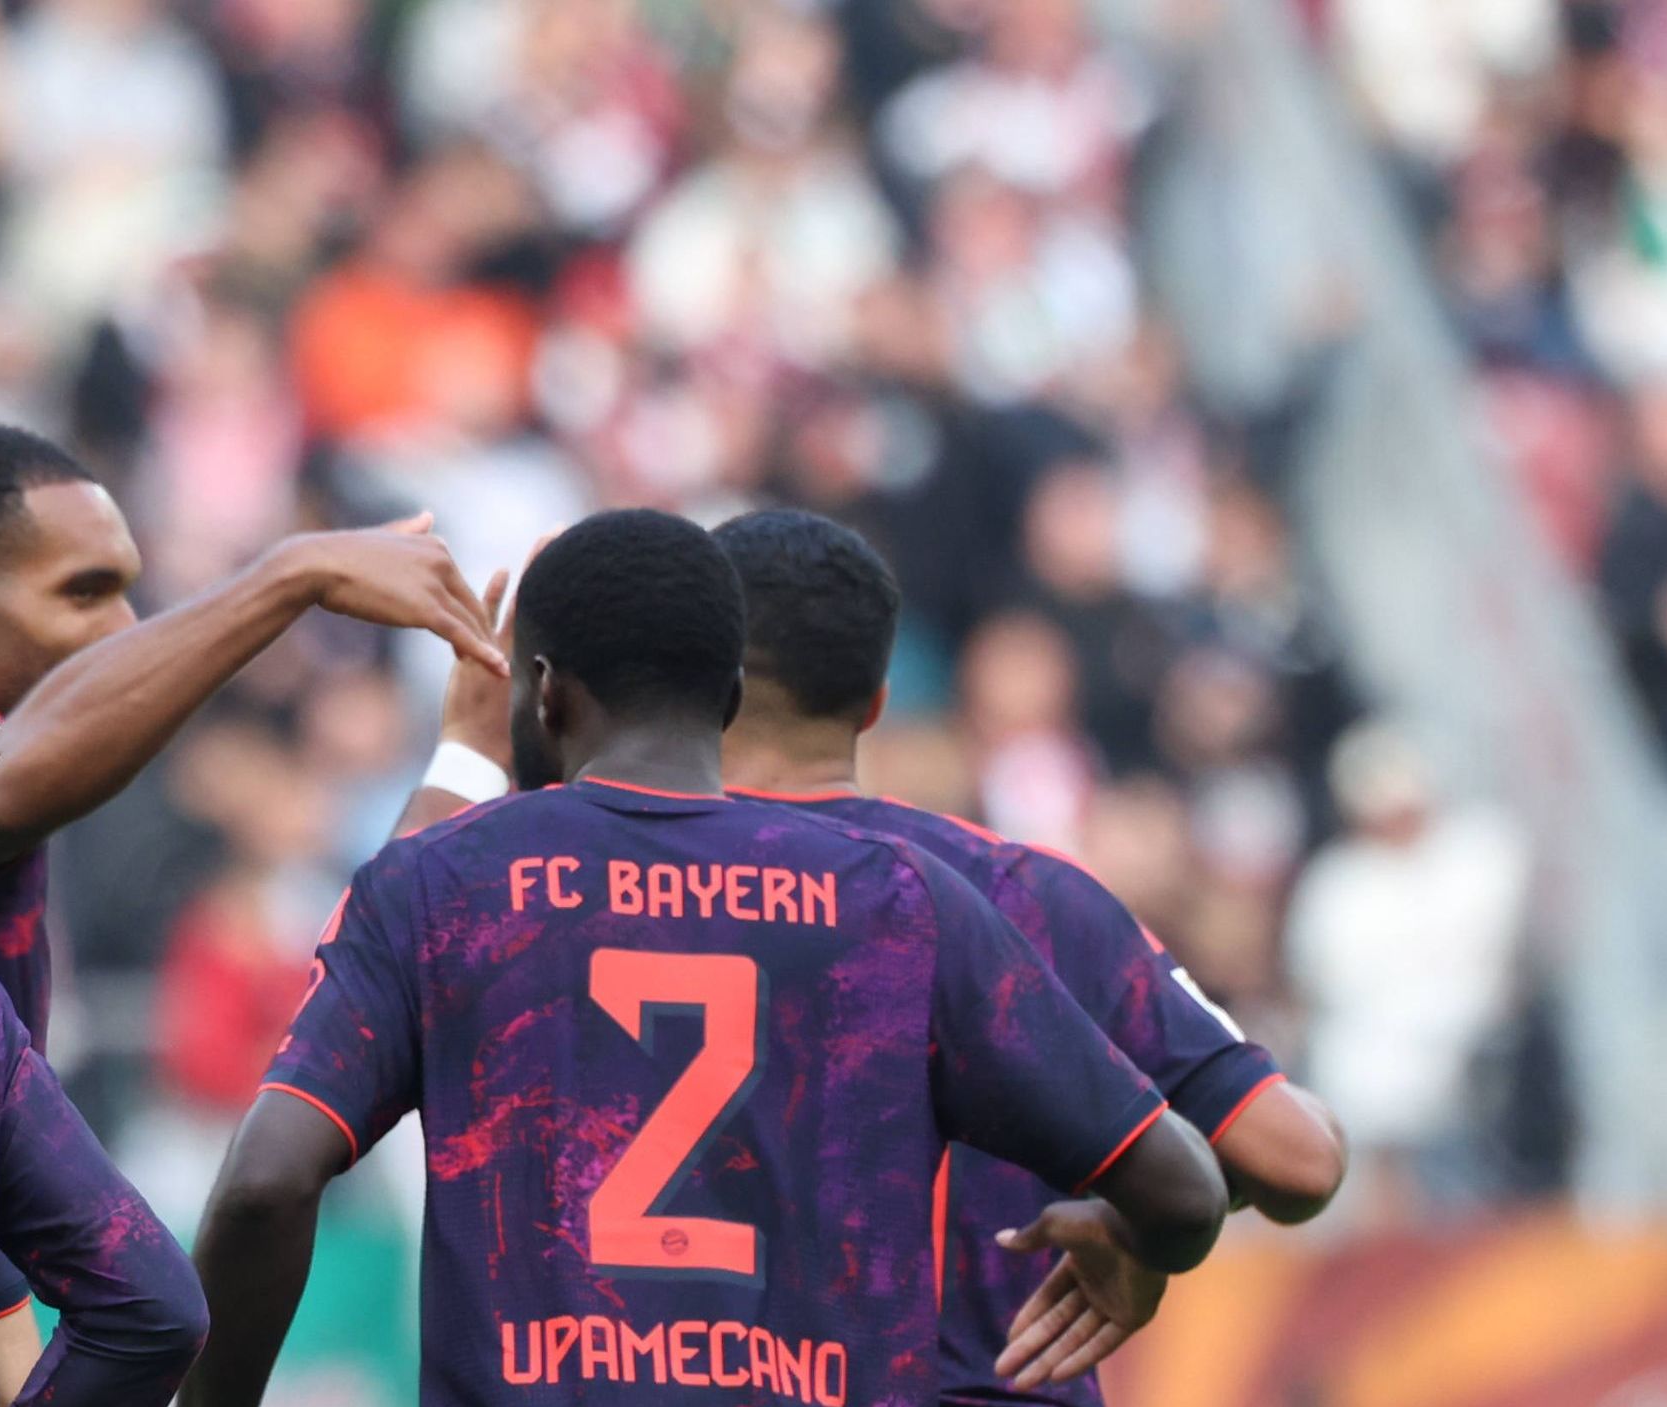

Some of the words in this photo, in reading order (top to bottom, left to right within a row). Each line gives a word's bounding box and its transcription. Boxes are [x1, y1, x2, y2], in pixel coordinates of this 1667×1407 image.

[509, 856, 583, 911] FC
[608, 860, 838, 927] BAYERN
[588, 948, 758, 1274] 2
